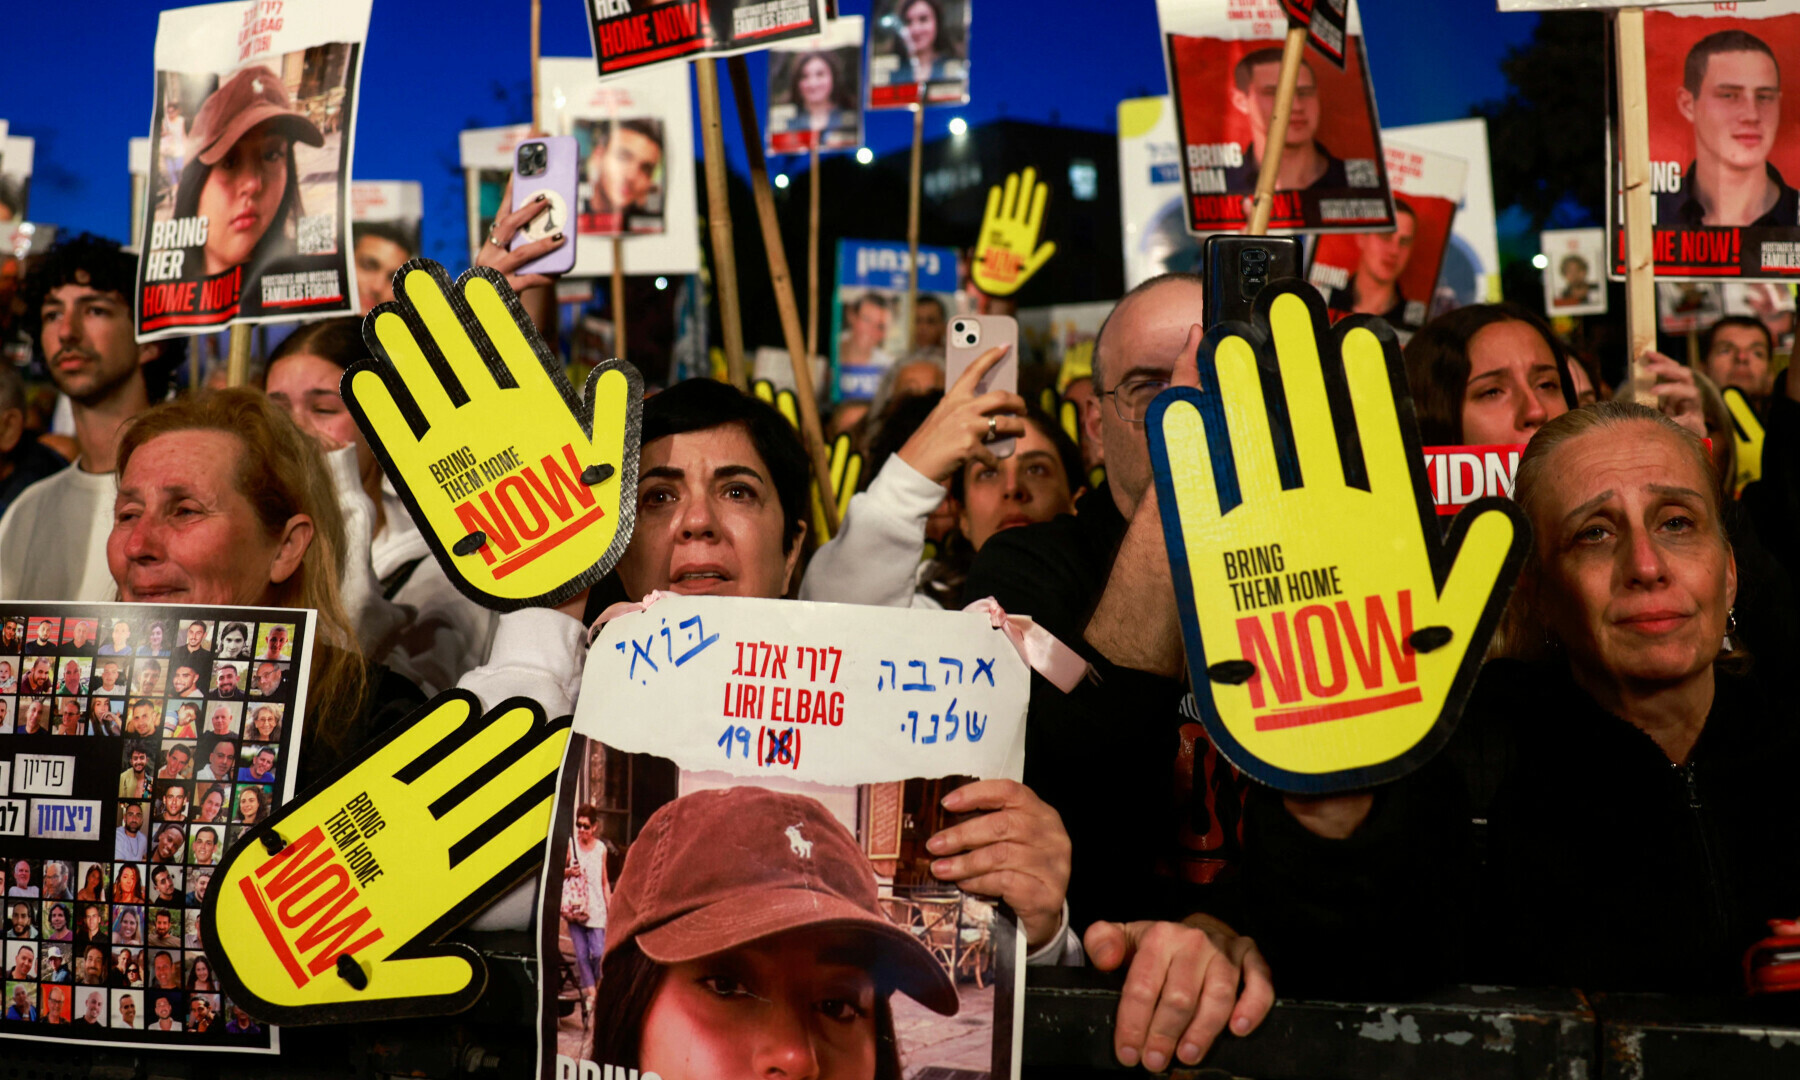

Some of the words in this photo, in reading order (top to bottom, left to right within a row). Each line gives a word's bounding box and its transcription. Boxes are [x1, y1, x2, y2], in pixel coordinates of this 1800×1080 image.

[599, 14, 653, 58] HOME
[652, 0, 711, 45] NOW!
[1187, 142, 1243, 169] BRING
[1190, 168, 1228, 194] HIM
[151, 215, 209, 250] BRING
[1681, 227, 1741, 264] NOW!
[146, 250, 185, 283] HER
[143, 281, 198, 319] HOME
[199, 264, 242, 312] NOW!
[428, 446, 477, 484] BRING
[440, 468, 485, 503] THEM
[479, 445, 524, 483] HOME
[454, 442, 596, 567] NOW
[1223, 543, 1285, 580] BRING
[1229, 576, 1284, 612] THEM
[1286, 566, 1343, 603] HOME
[732, 640, 789, 680] אלבג
[796, 646, 843, 684] לירי
[1235, 588, 1418, 710] NOW
[877, 656, 996, 692] אהבה
[723, 682, 766, 720] LIRI
[770, 686, 845, 727] ELBAG
[717, 724, 752, 760] 19
[24, 759, 65, 790] פדיון
[37, 804, 93, 836] ניצחון
[345, 791, 387, 840] BRING
[324, 807, 361, 853] THEM
[344, 842, 385, 889] HOME
[254, 825, 386, 978] NOW
